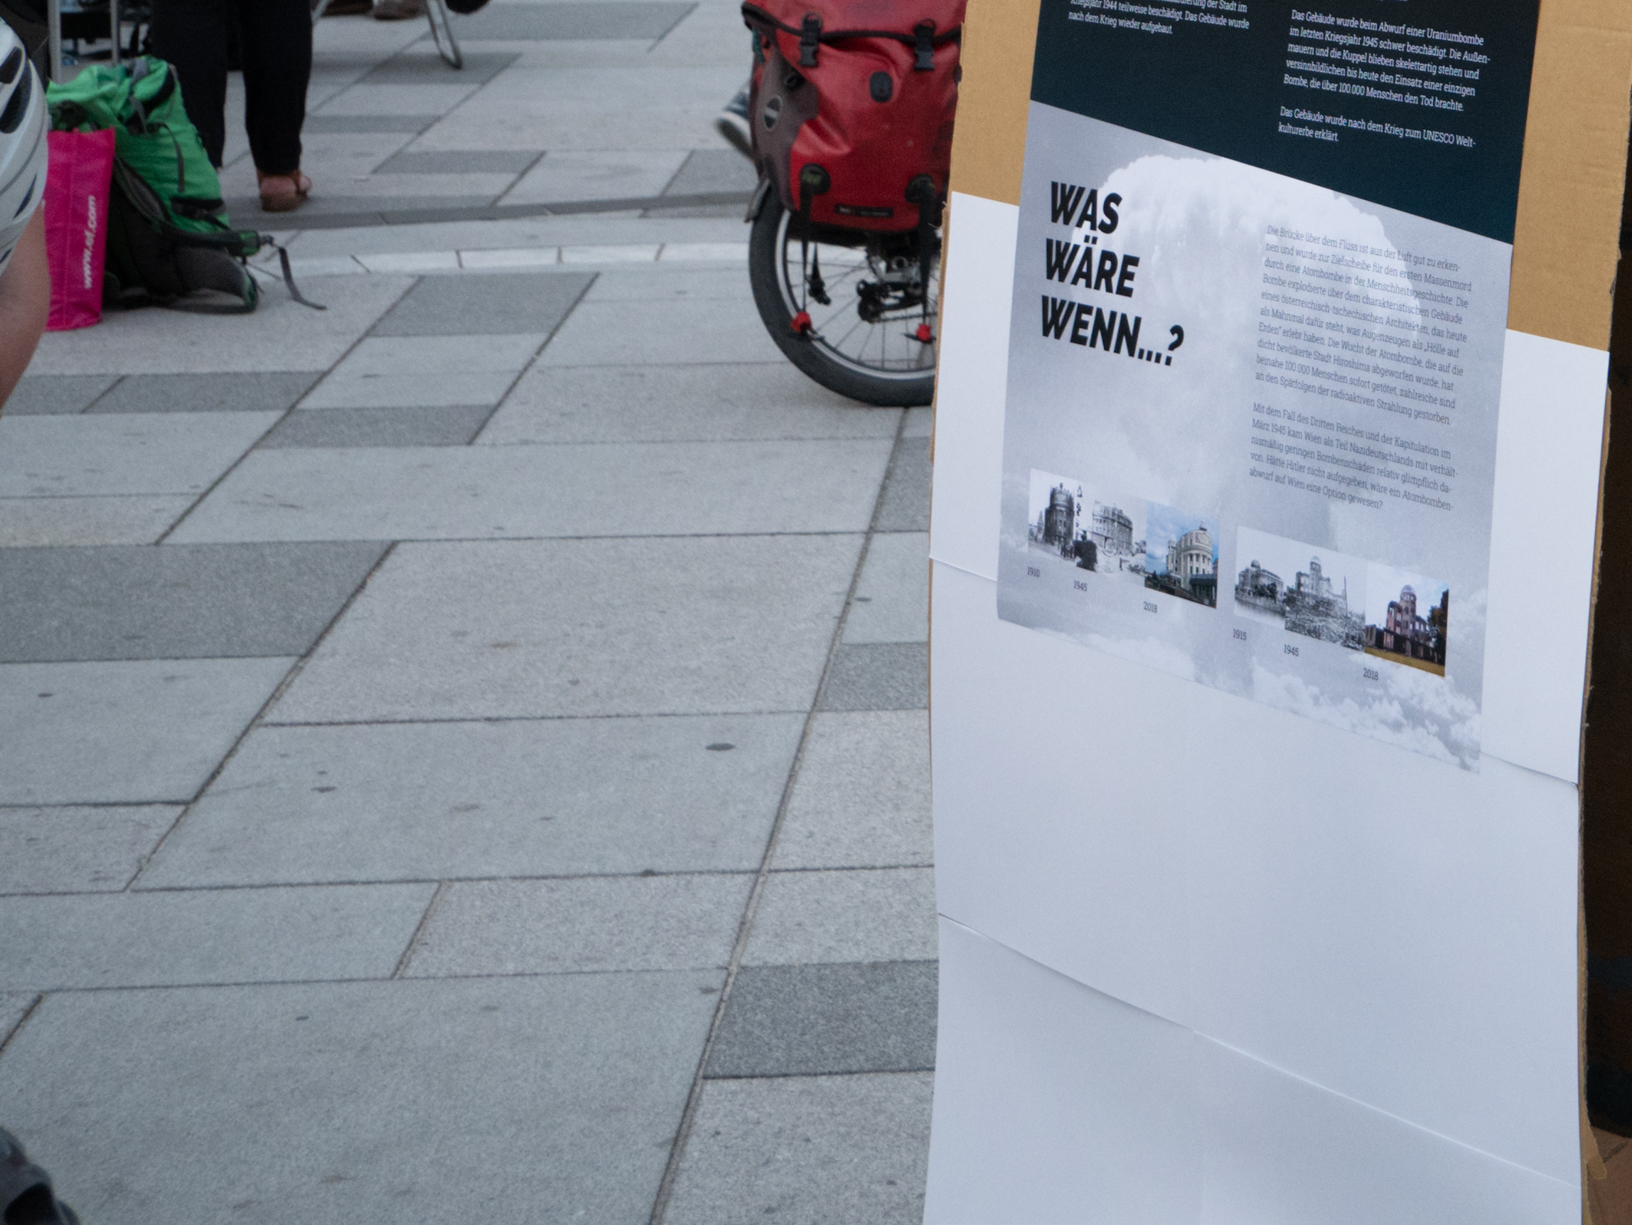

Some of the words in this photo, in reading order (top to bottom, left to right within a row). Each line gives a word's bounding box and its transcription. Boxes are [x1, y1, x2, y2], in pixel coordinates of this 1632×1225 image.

[1068, 12, 1084, 21] nach
[1084, 12, 1098, 23] dem
[1099, 14, 1117, 27] Krieg
[1118, 18, 1139, 29] wieder
[1102, 0, 1117, 10] 1944
[1118, 1, 1147, 14] teilweise
[1184, 11, 1197, 21] Das
[1198, 13, 1226, 26] Gebäude
[1227, 19, 1249, 29] wurde
[1218, 0, 1236, 10] Stadt
[1237, 2, 1247, 12] im
[1291, 9, 1304, 20] Das
[1305, 11, 1334, 24] Gebäude
[1336, 17, 1358, 28] wurde
[1359, 18, 1377, 30] beim
[1378, 21, 1405, 34] Abwurf
[1406, 26, 1424, 37] einer
[1426, 28, 1483, 45] Uraniumbombe
[1289, 25, 1299, 36] im
[1300, 27, 1323, 40] letzten
[1324, 30, 1360, 45] Kriegsjahr
[1362, 36, 1378, 47] 1945
[1378, 39, 1404, 51] schwer
[1448, 48, 1461, 59] Die
[1462, 50, 1490, 63] Außen-
[1287, 44, 1314, 54] mauern
[1315, 46, 1329, 57] und
[1330, 47, 1341, 58] die
[1342, 49, 1367, 63] Kuppel
[1368, 53, 1394, 66] blieben
[1395, 58, 1436, 74] skelettartig
[1438, 64, 1462, 76] stehen
[1464, 68, 1479, 79] und
[1285, 60, 1345, 76] versinnbildlichen
[1346, 66, 1357, 78] bis
[1358, 68, 1378, 81] heute
[1379, 72, 1393, 83] den
[1394, 74, 1421, 88] Einsatz
[1423, 79, 1442, 91] einer
[1443, 82, 1475, 96] einzigen
[1309, 77, 1320, 88] die
[1321, 79, 1337, 91] über
[1365, 86, 1402, 101] Menschen
[1404, 92, 1418, 104] den
[1420, 94, 1434, 106] Tod
[1278, 122, 1313, 137] kulturerbe
[1280, 106, 1292, 117] Das
[1293, 108, 1323, 122] Gebäude
[1324, 115, 1346, 126] wurde
[1347, 119, 1366, 129] nach
[1366, 120, 1383, 132] dem
[1384, 122, 1403, 137] Krieg
[1405, 128, 1421, 138] zum
[1422, 129, 1454, 144] UNESCO
[1455, 134, 1476, 146] Welt-
[1051, 180, 1123, 234] WAS
[1046, 234, 1140, 298] WÄRE
[1041, 294, 1185, 366] WENN...?
[1257, 337, 1275, 350] dicht
[1276, 341, 1311, 358] bevölkerte
[1313, 350, 1331, 363] Stadt
[1333, 354, 1370, 372] Hiroshima
[1371, 364, 1413, 382] abgeworfen
[1441, 379, 1453, 391] hat
[1249, 467, 1273, 481] abwurf
[1274, 474, 1285, 484] auf
[1287, 476, 1304, 489] Wien
[1306, 482, 1321, 493] eine
[1322, 485, 1346, 500] Option
[1347, 494, 1382, 509] gewesen?
[1073, 580, 1088, 592] 1945
[1143, 600, 1158, 613] 2018
[1232, 628, 1247, 641] 1915
[1283, 644, 1299, 656] 1945
[1363, 667, 1379, 681] 2018
